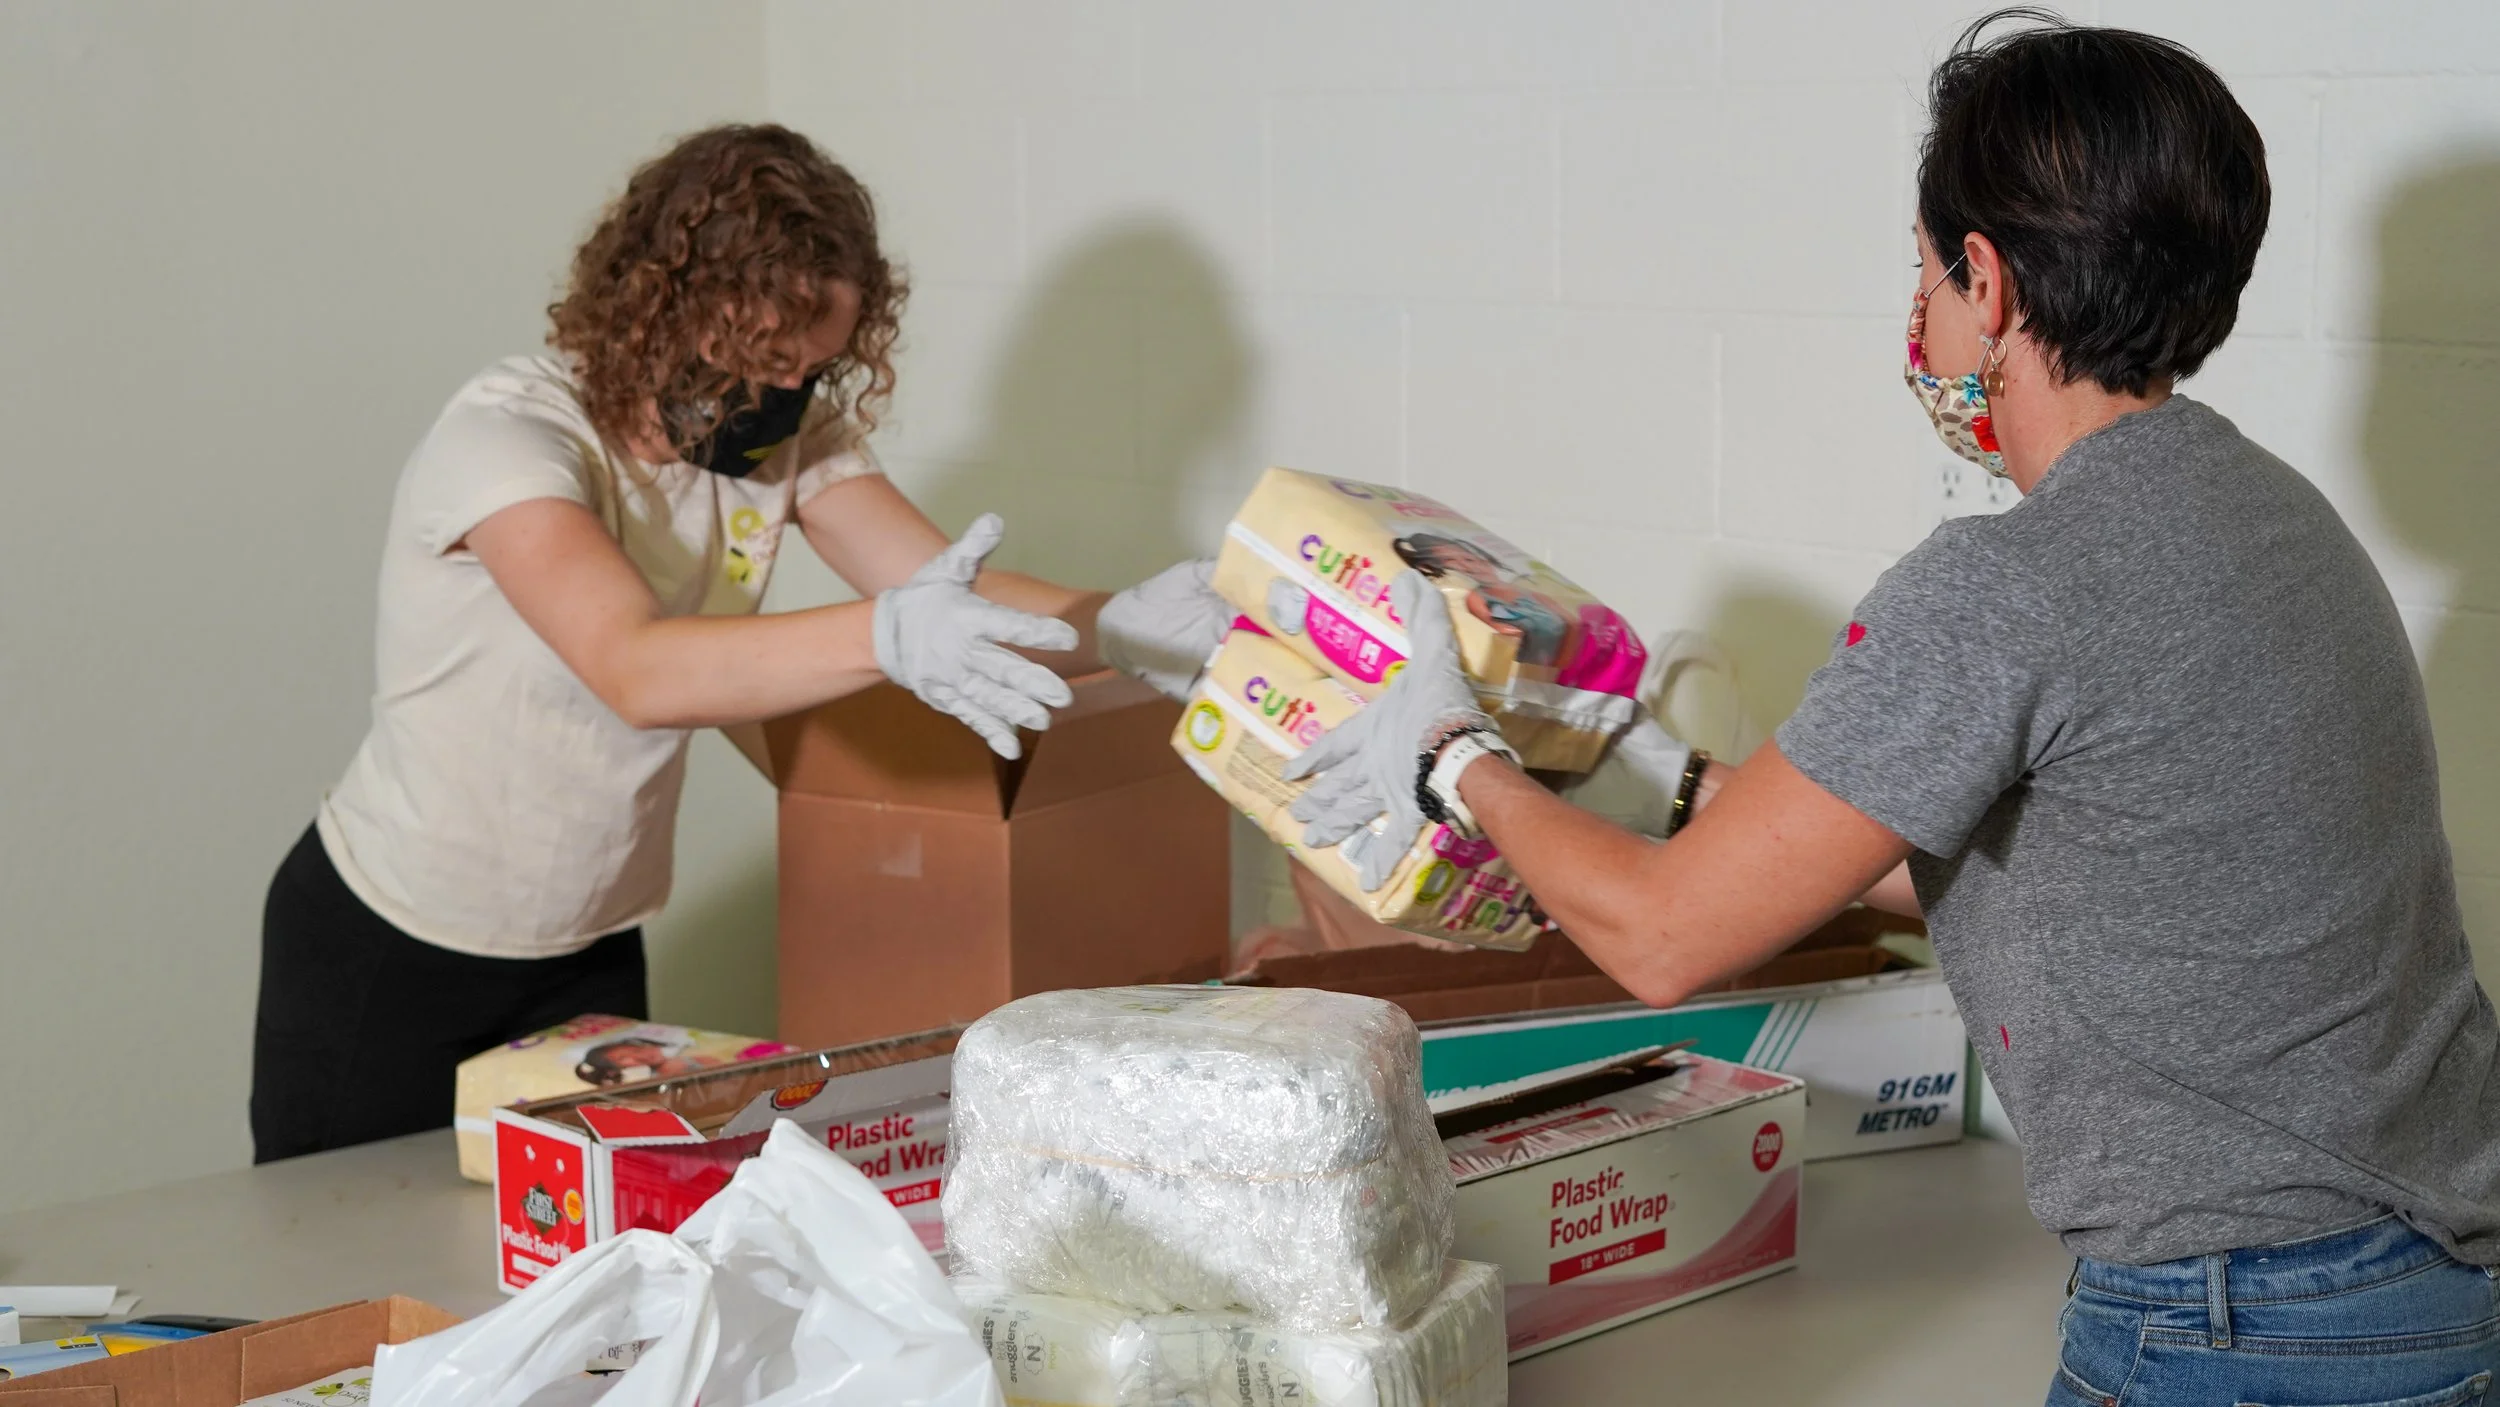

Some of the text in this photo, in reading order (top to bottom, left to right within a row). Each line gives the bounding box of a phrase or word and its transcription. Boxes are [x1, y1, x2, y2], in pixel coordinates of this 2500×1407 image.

[1878, 1072, 1957, 1103] 916M
[828, 1112, 915, 1151] Plastic
[893, 1184, 933, 1205] WIDE
[1549, 1193, 1669, 1249] Food Wrap
[1602, 1242, 1636, 1264] WIDE
[1026, 1345, 1042, 1363] N
[1281, 1382, 1300, 1399] N
